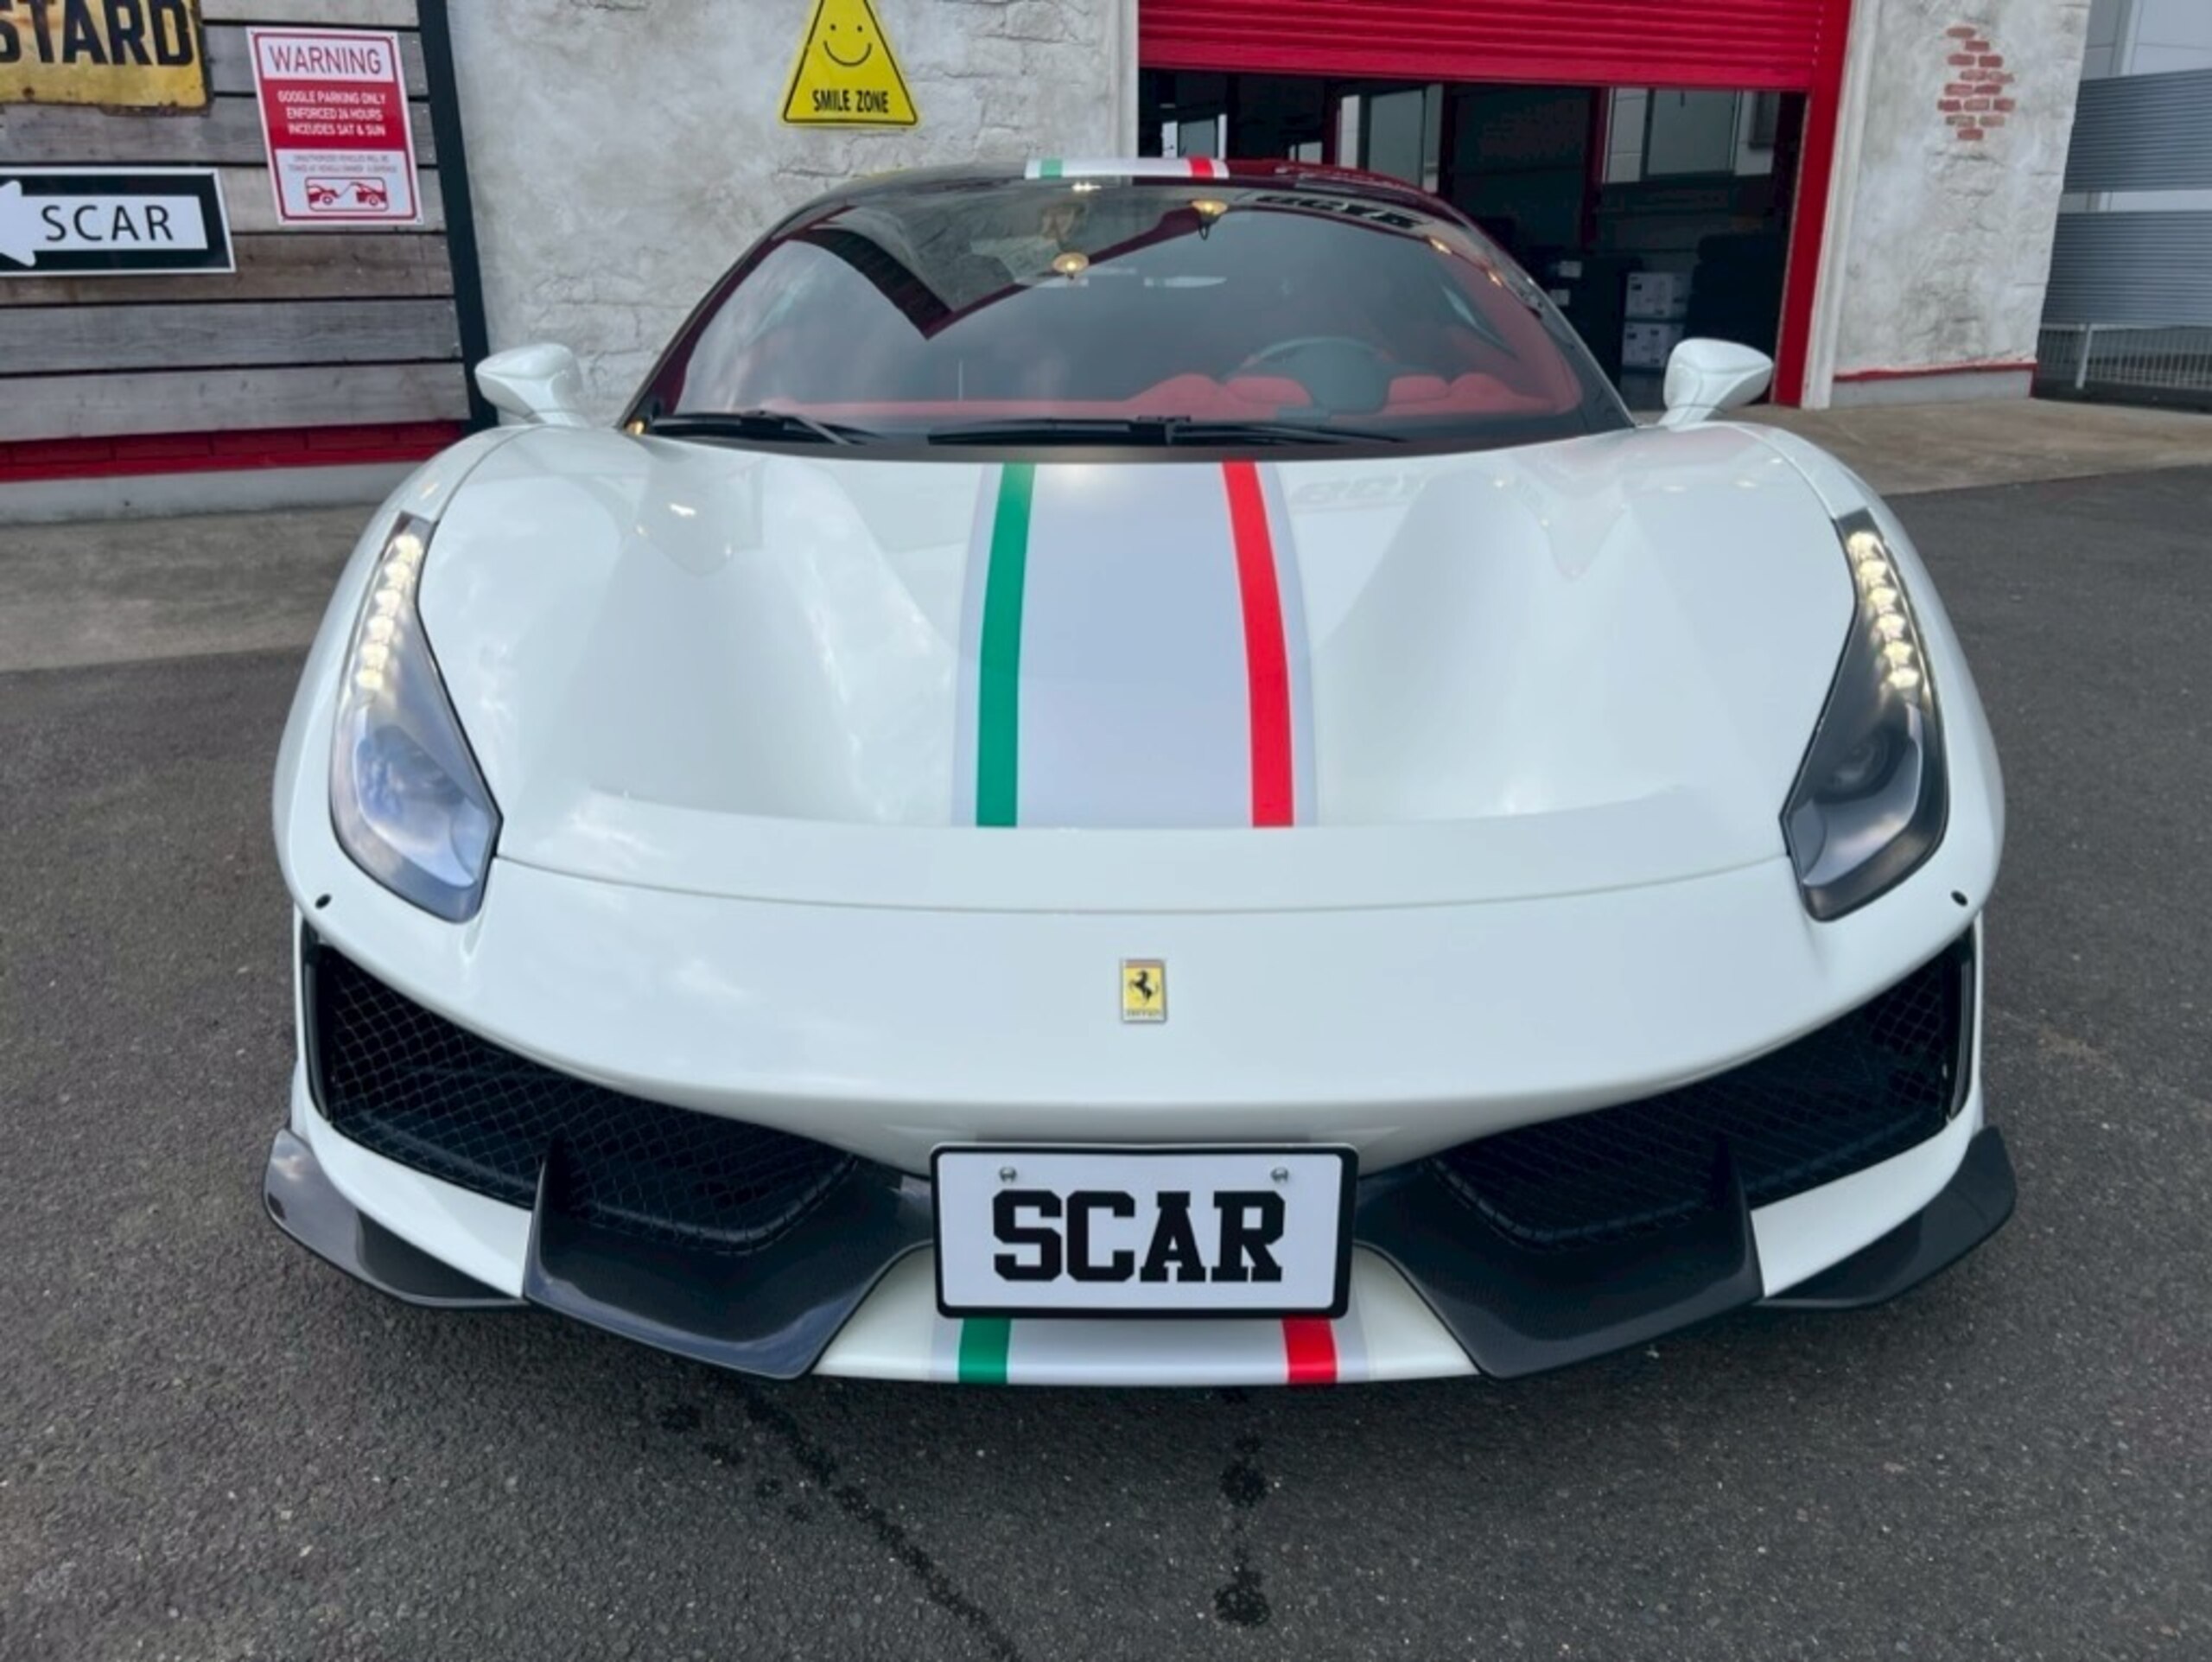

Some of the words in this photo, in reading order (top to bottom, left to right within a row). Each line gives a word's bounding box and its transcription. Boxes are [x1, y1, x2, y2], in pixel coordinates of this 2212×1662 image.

[268, 45, 382, 74] WARNING
[277, 90, 315, 103] GOOGLE
[316, 91, 359, 105] PARKING
[360, 92, 385, 105] ONLY
[812, 89, 851, 111] SMILE
[855, 91, 889, 113] ZONE
[286, 106, 337, 120] ENFORCED
[349, 108, 384, 122] HOURS
[336, 124, 355, 136] SAT
[365, 124, 386, 137] SUN
[41, 205, 174, 242] SCAR
[993, 1189, 1286, 1283] SCAR
